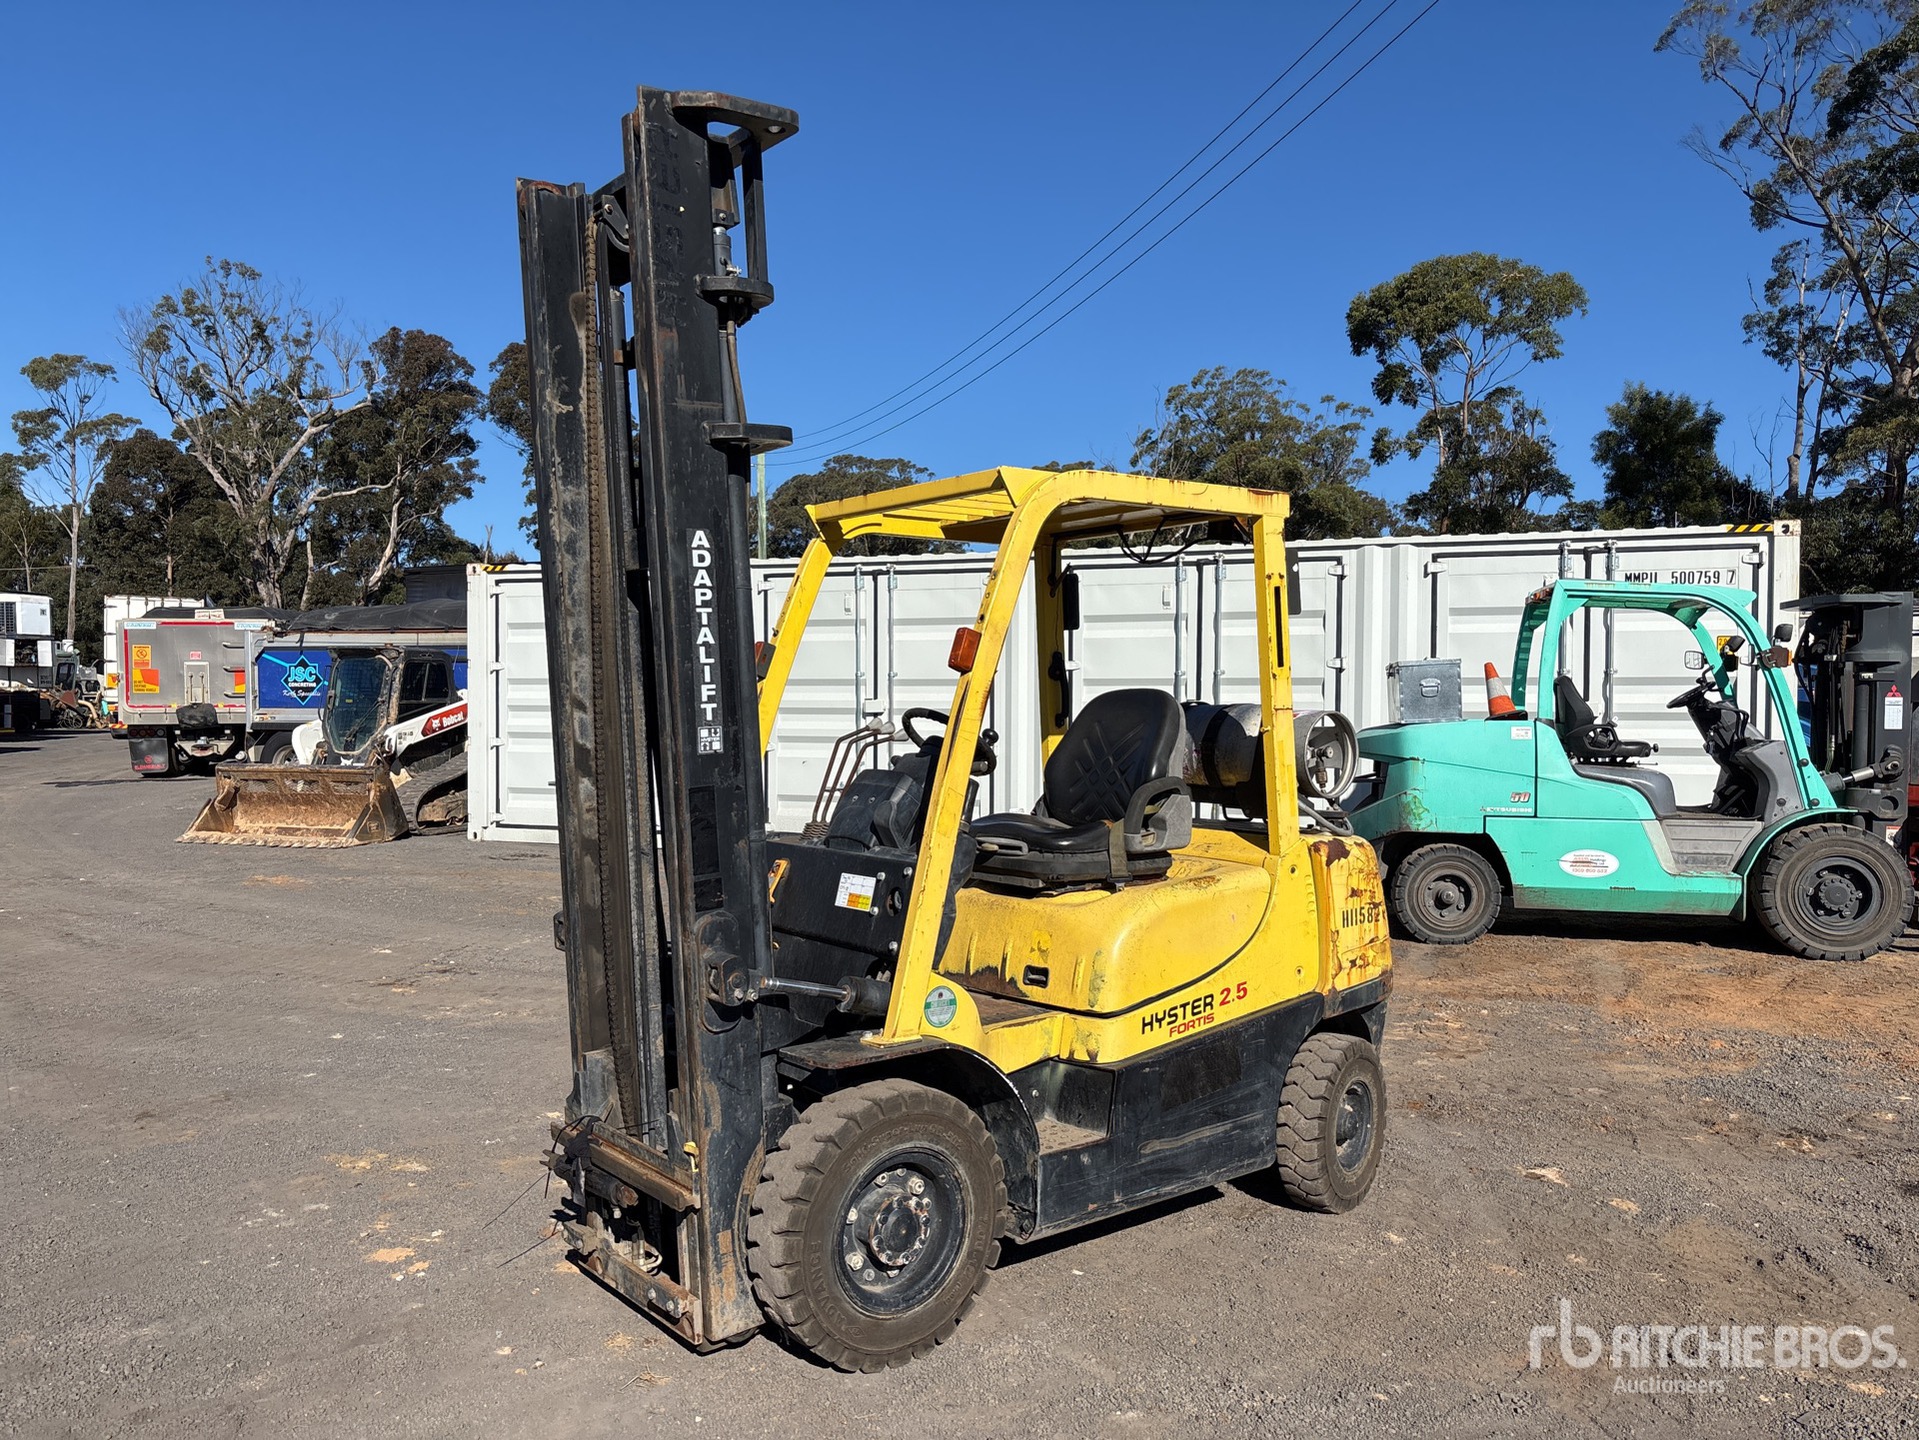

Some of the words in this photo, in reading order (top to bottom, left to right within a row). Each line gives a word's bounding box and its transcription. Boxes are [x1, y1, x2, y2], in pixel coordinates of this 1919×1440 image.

[1670, 570, 1721, 585] 500759
[691, 529, 718, 721] ADAPTALIFT
[287, 666, 316, 682] JSC
[442, 711, 464, 728] Bobcat
[1141, 993, 1214, 1035] HYSTER
[1219, 981, 1248, 1007] 2.5
[1169, 1012, 1215, 1038] FORTIS
